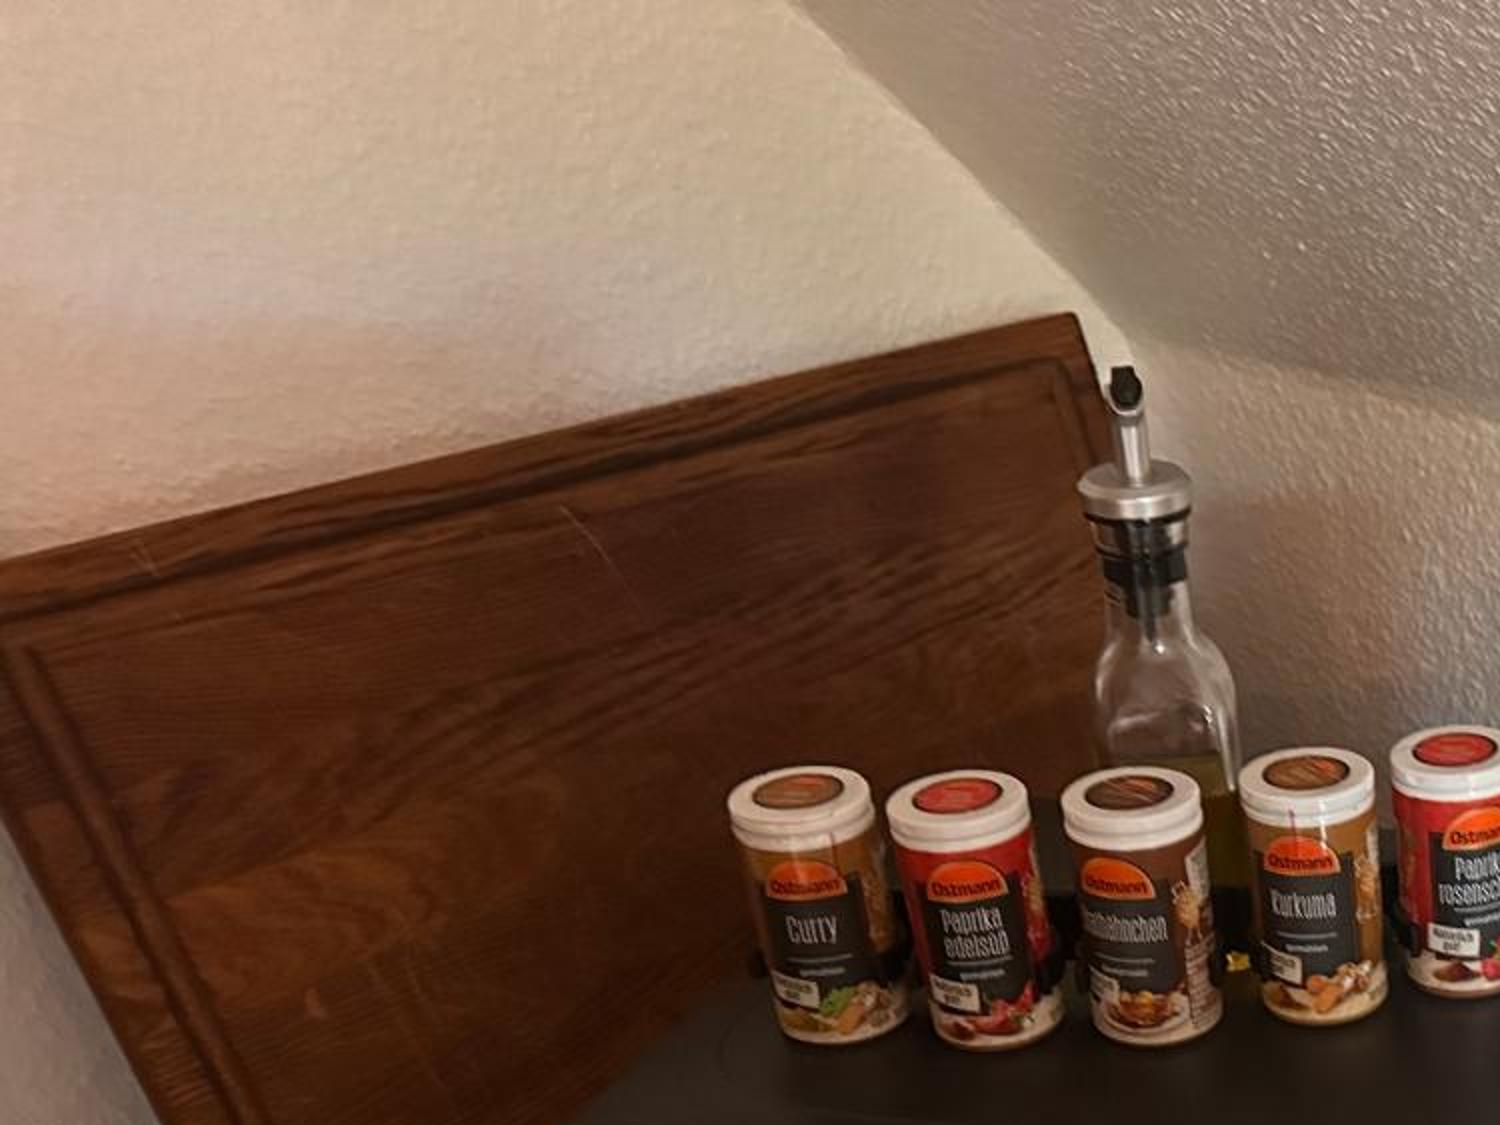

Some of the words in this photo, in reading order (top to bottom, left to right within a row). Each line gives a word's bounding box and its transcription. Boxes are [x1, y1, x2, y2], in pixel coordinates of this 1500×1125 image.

[1267, 852, 1333, 870] Ostmann
[932, 878, 1002, 896] Ostmann
[1085, 873, 1148, 894] Ostmann
[1270, 887, 1336, 920] Kurkuma
[785, 913, 838, 945] Curry
[940, 906, 1003, 936] Paprika
